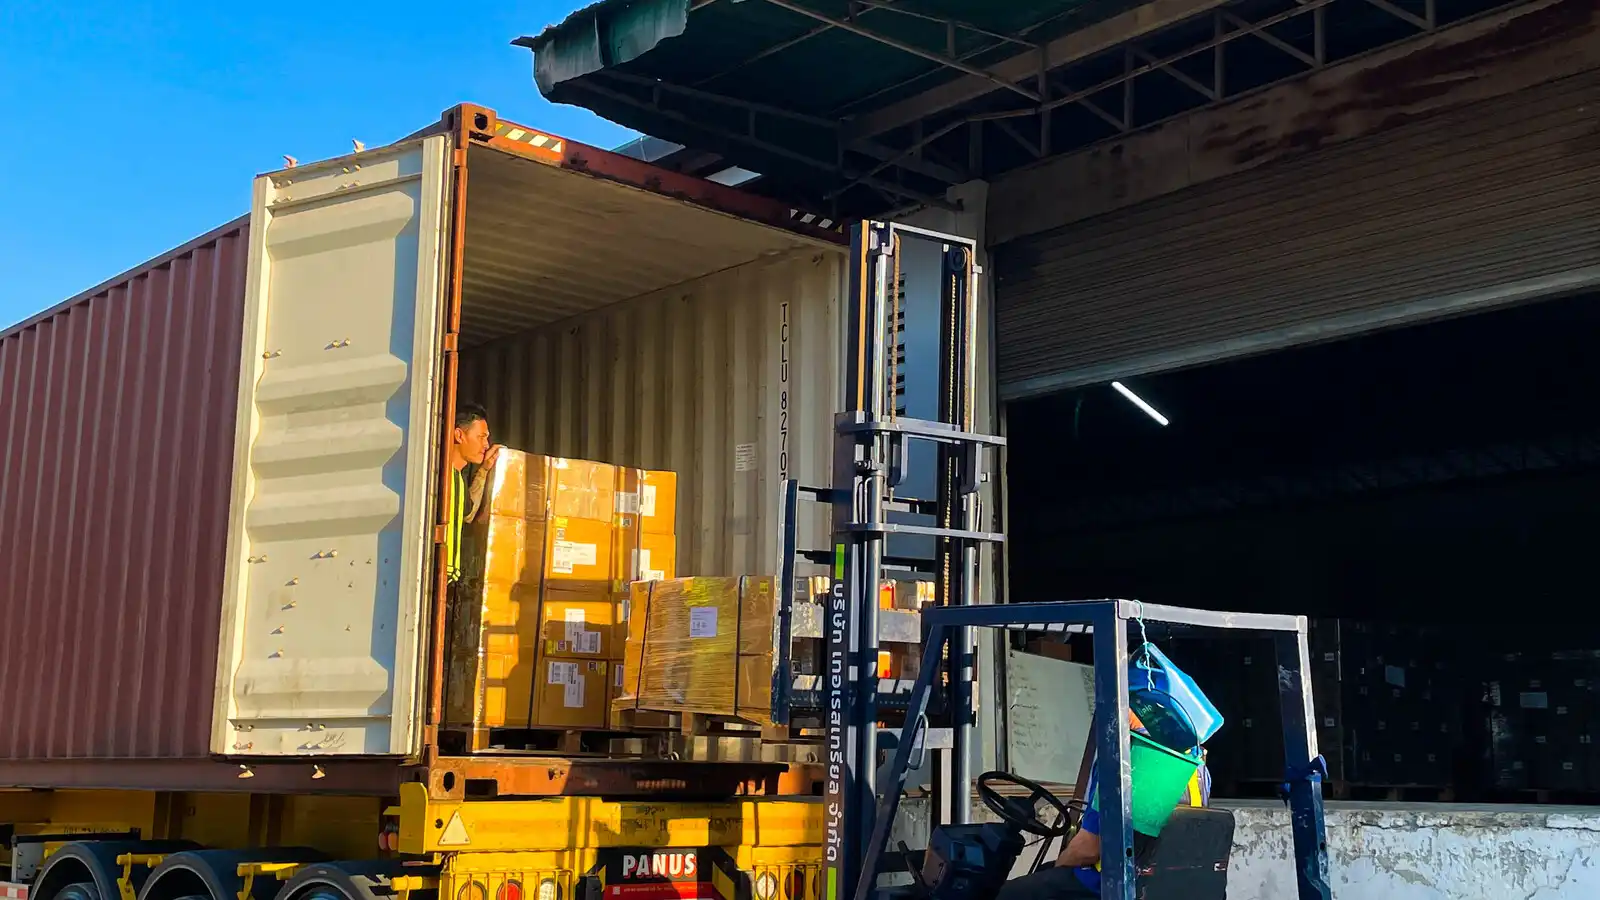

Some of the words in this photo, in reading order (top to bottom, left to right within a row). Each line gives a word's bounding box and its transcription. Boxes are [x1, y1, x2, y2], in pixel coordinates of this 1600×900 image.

[780, 303, 788, 383] TCLU
[832, 583, 846, 643] บริษัท
[828, 651, 844, 795] เทอเรสเทรียล
[826, 802, 842, 862] จำกัด
[622, 853, 697, 878] PANUS
